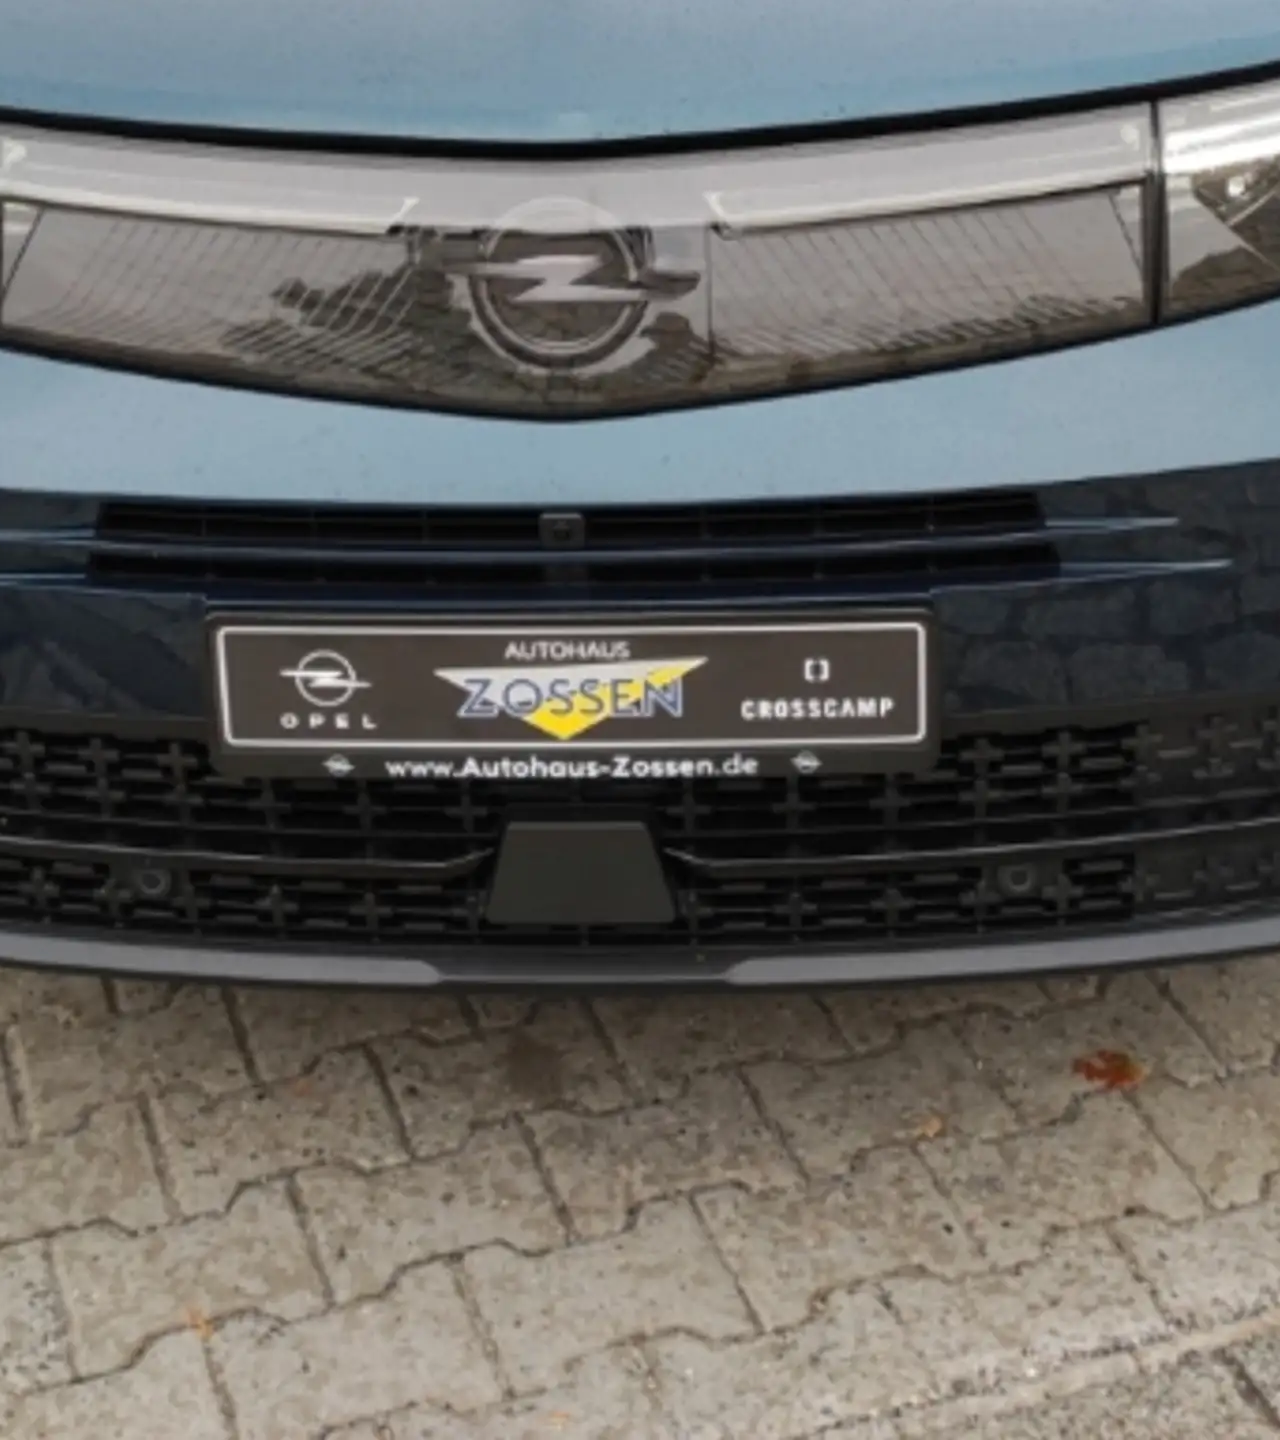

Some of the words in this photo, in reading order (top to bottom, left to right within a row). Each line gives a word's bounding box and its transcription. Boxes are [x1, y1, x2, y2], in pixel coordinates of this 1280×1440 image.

[504, 641, 631, 660] AUTOHAUS
[457, 676, 684, 719] ZOSSEN
[740, 696, 895, 721] CROSSCAMP
[280, 712, 378, 729] OPEL
[385, 753, 759, 778] www.Autohaus-Zossen.de
